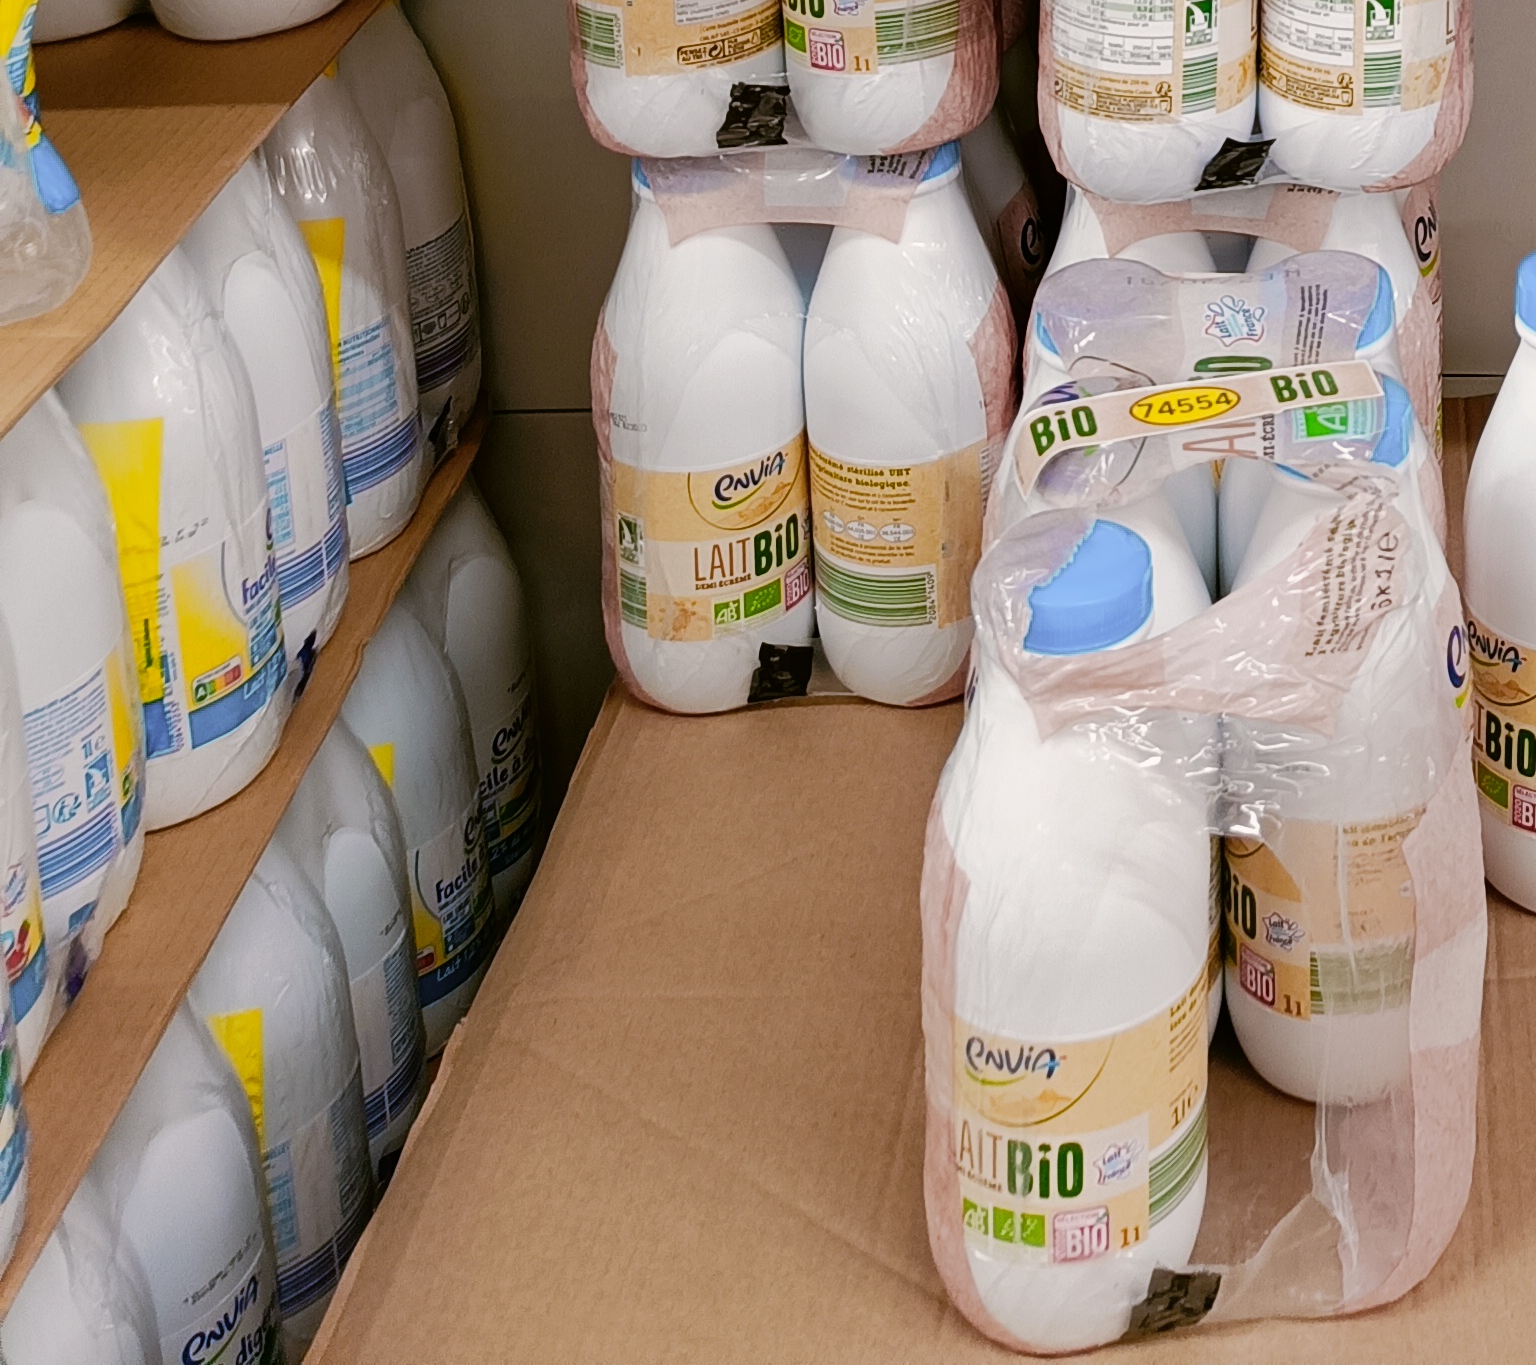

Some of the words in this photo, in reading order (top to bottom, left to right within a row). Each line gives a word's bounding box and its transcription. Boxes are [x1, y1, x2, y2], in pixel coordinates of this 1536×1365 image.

[816, 42, 845, 70] BIO
[1137, 391, 1234, 421] 74554
[694, 536, 752, 582] LAIT
[1245, 966, 1276, 1003] BIO
[958, 1118, 1004, 1187] AIT
[1065, 1226, 1108, 1259] BIO
